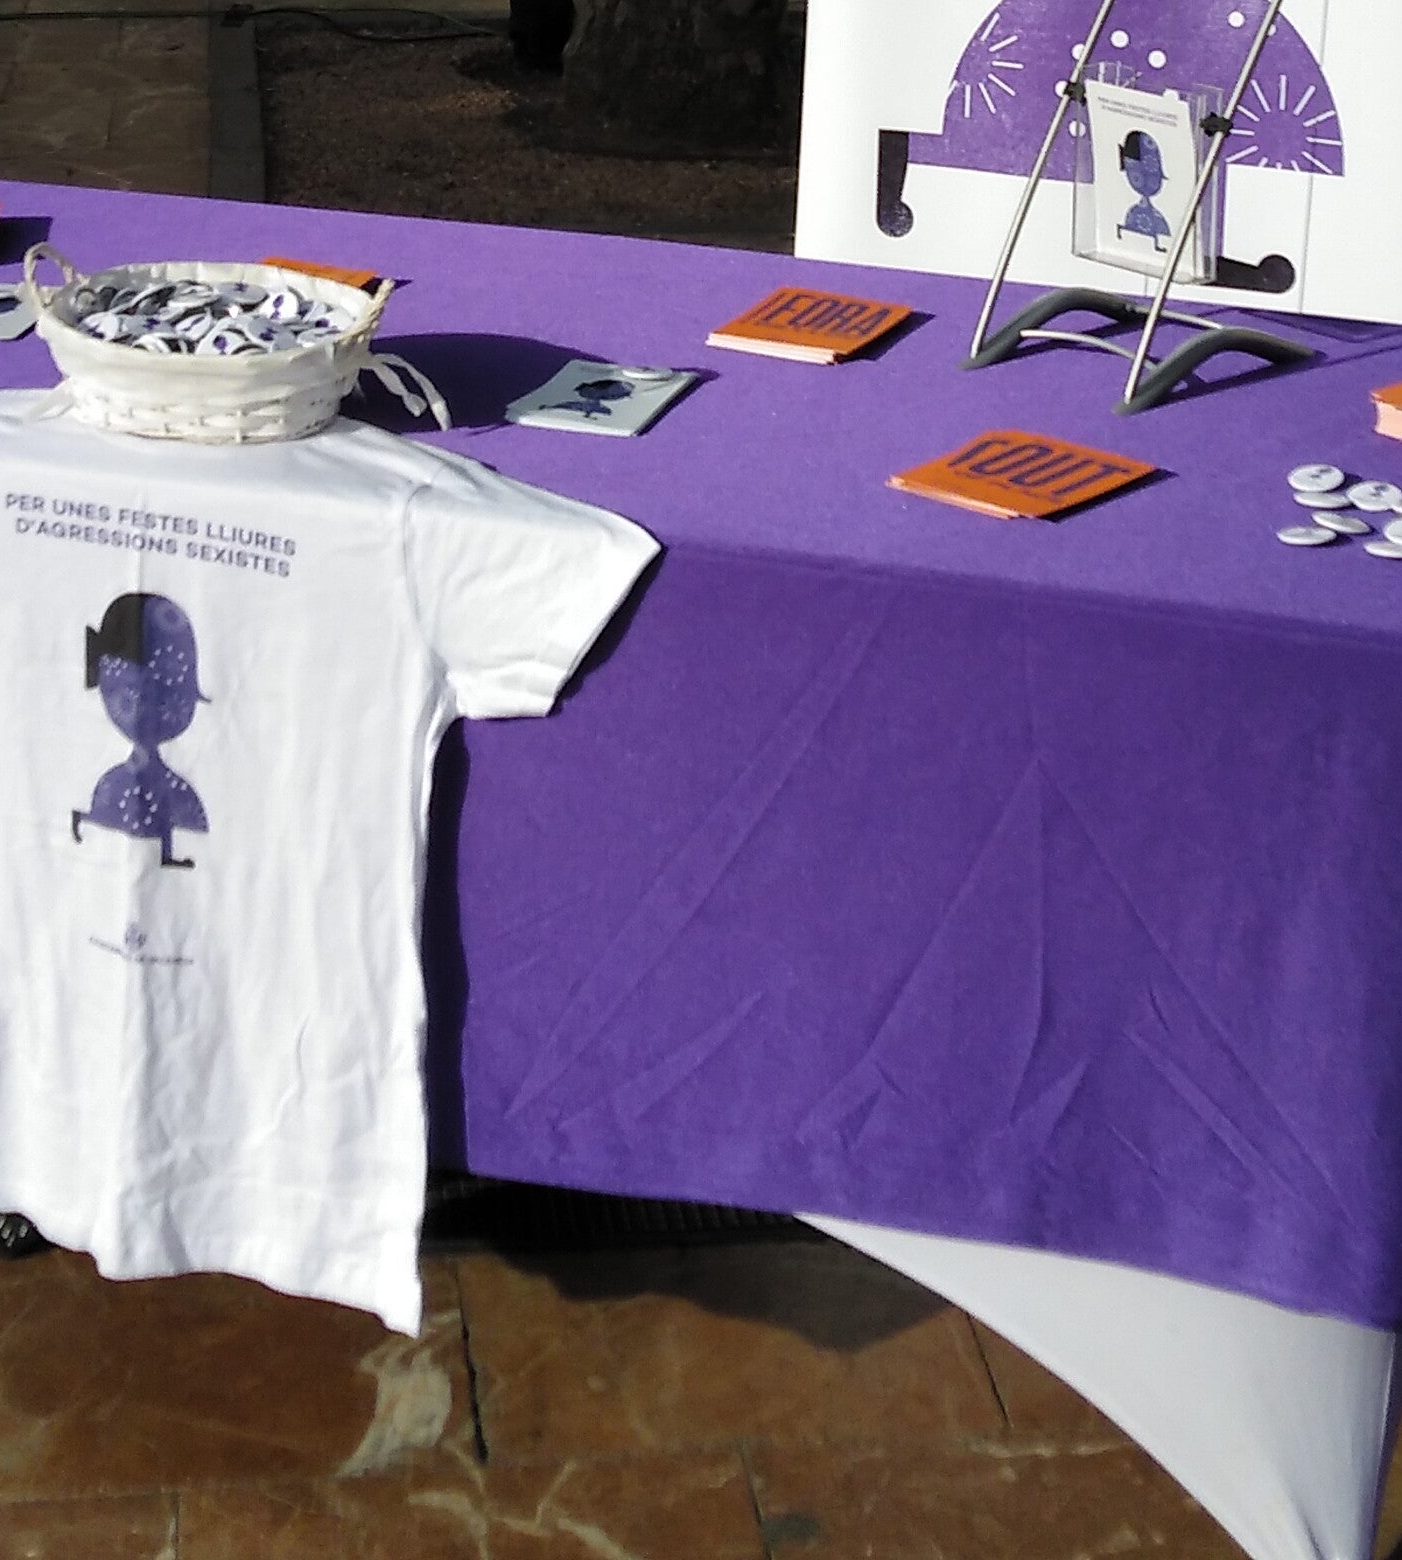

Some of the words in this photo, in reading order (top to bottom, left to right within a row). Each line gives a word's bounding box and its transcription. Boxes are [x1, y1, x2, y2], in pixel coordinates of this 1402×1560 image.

[5, 492, 45, 513] PER
[52, 498, 111, 523] UNES
[118, 507, 198, 536] FESTES
[206, 521, 297, 557] LLIURES
[15, 516, 178, 556] D'AGRESSIONS
[185, 541, 291, 578] SEXISTES
